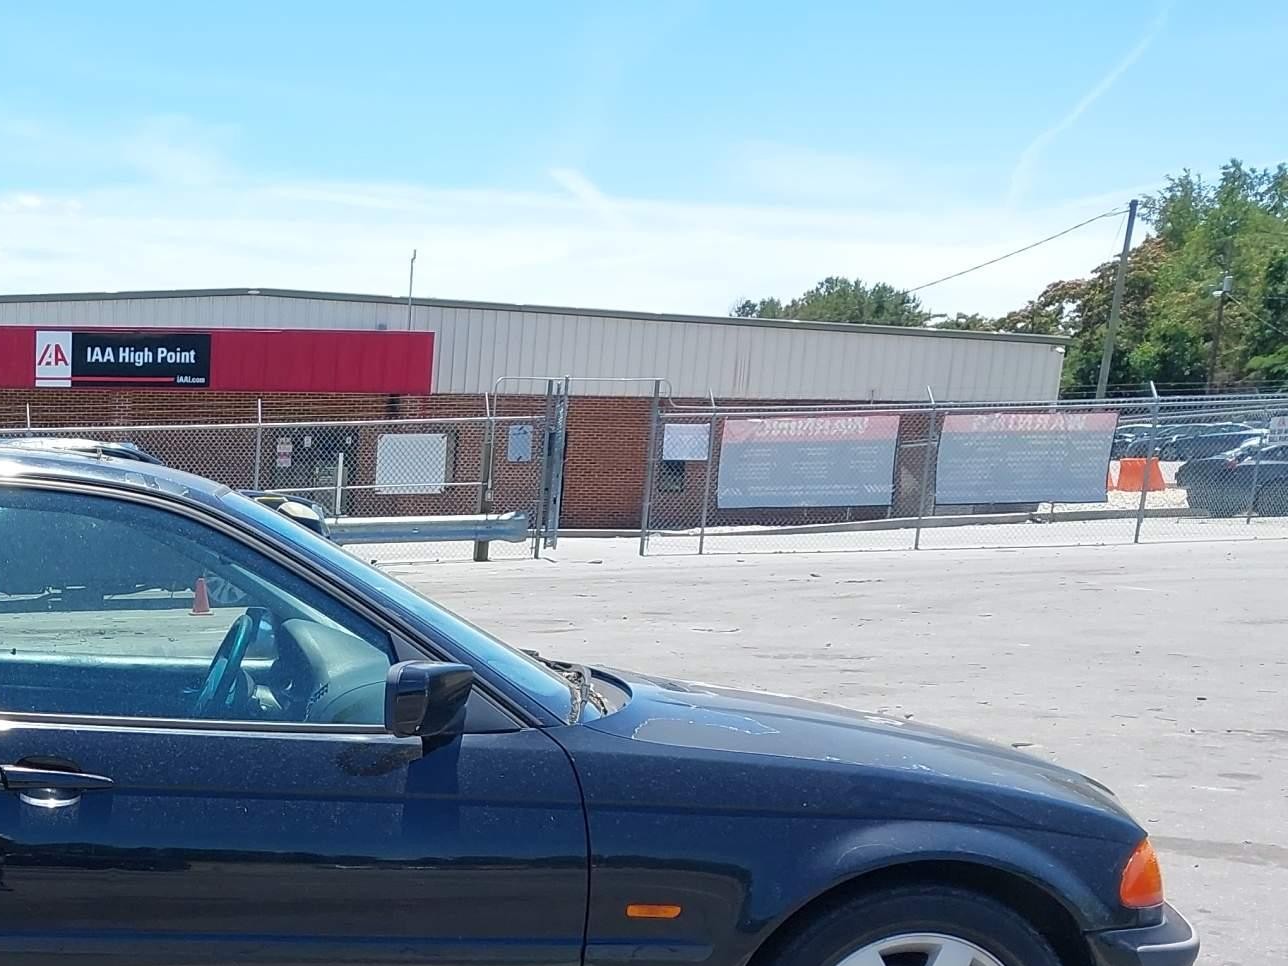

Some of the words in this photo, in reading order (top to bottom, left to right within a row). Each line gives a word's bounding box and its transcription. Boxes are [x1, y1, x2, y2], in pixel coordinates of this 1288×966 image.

[87, 347, 114, 363] IAA
[119, 348, 153, 366] High
[157, 348, 196, 364] Point
